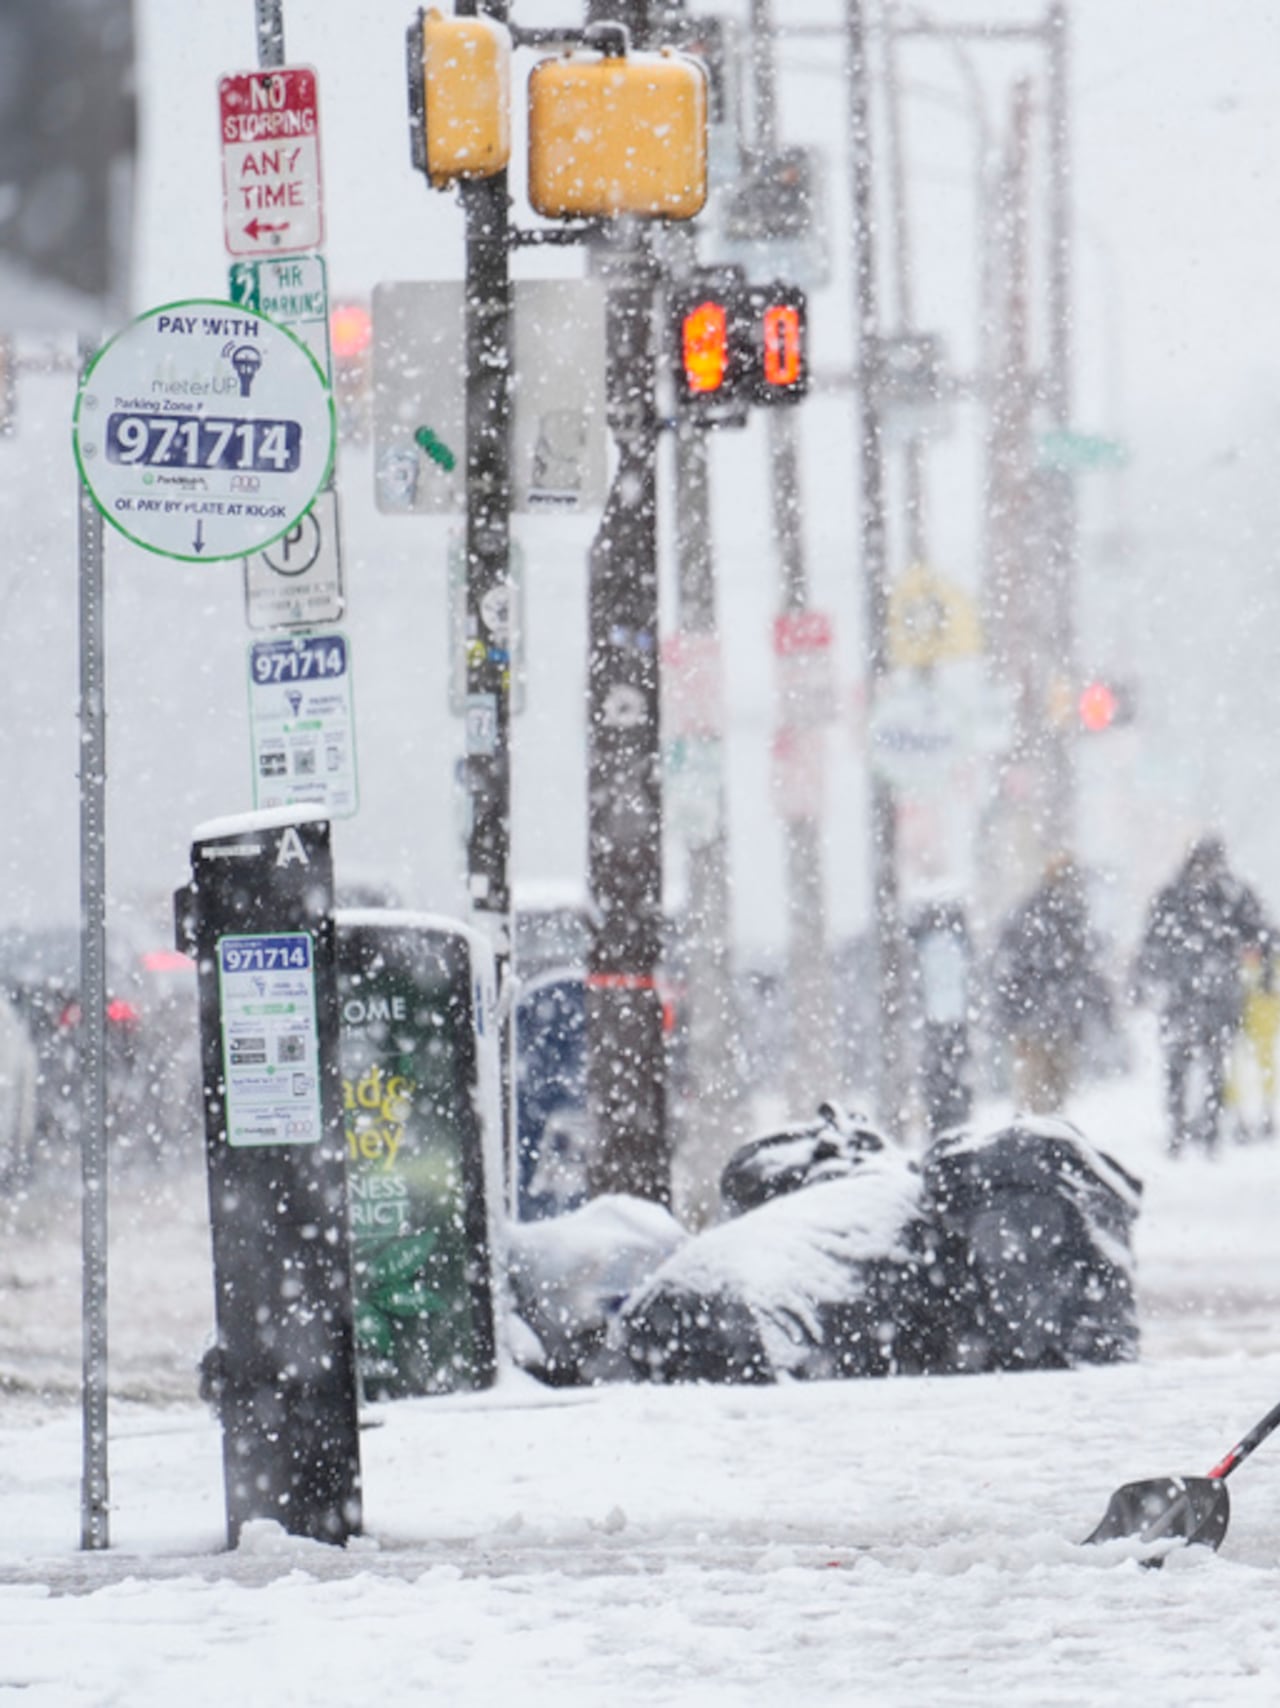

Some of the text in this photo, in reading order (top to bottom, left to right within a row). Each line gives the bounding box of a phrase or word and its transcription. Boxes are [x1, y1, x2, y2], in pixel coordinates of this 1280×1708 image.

[250, 74, 286, 110] NO
[224, 108, 315, 141] STOPPING
[242, 147, 302, 176] ANY
[240, 181, 304, 210] TIME
[279, 265, 303, 289] HR
[262, 292, 325, 315] PARKING
[157, 316, 259, 337] PAY WITH
[152, 376, 237, 396] meterUP
[114, 397, 160, 412] Parking
[163, 399, 193, 411] Zone
[116, 416, 291, 470] 971714
[137, 499, 160, 512] PAY
[164, 500, 181, 513] BY
[184, 501, 225, 516] PLATE
[227, 503, 243, 515] AT
[244, 504, 286, 518] KIOSK
[255, 647, 342, 681] 971714
[277, 826, 310, 867] A
[226, 946, 305, 970] 971714
[343, 996, 407, 1023] OME
